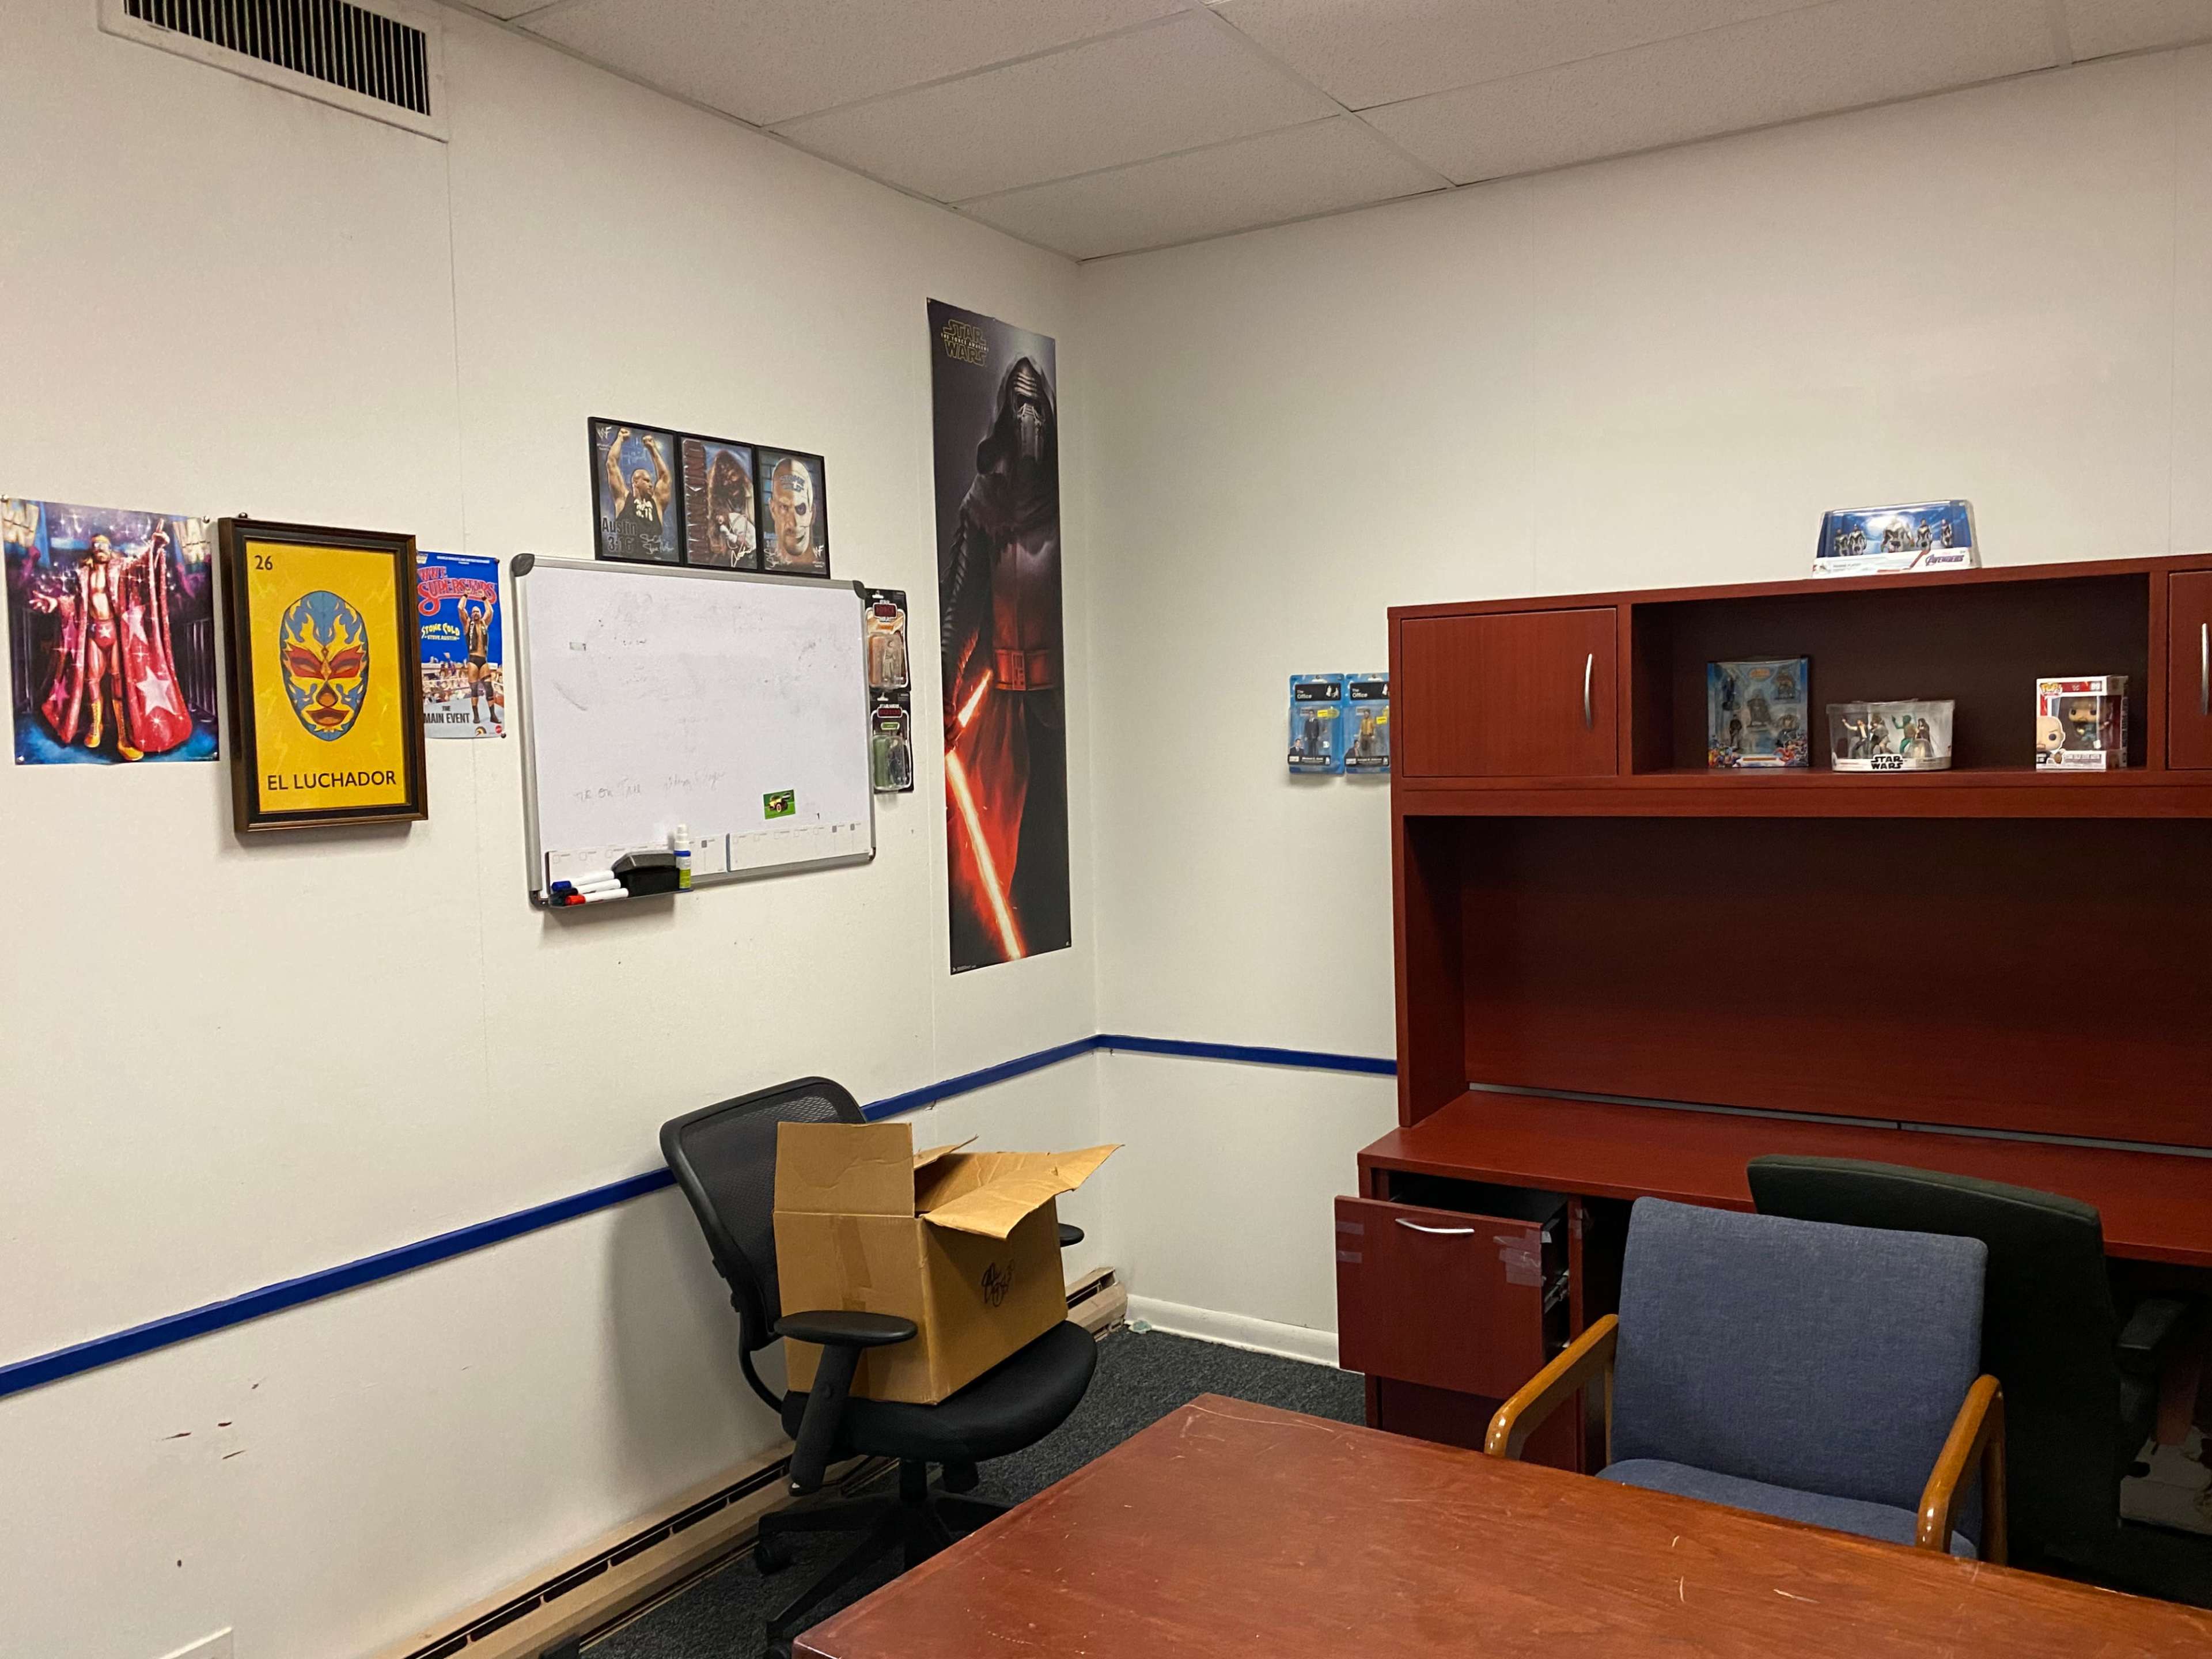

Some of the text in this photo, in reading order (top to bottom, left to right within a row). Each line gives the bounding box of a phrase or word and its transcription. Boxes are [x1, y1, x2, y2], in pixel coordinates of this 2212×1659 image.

[943, 319, 987, 346] STAR
[944, 339, 987, 366] WARS
[602, 516, 638, 536] Austin
[254, 555, 274, 571] 26
[417, 578, 497, 617] SUPERSTARS
[424, 713, 470, 724] MAIN EVENT
[267, 770, 397, 790] EL LUCHADOR
